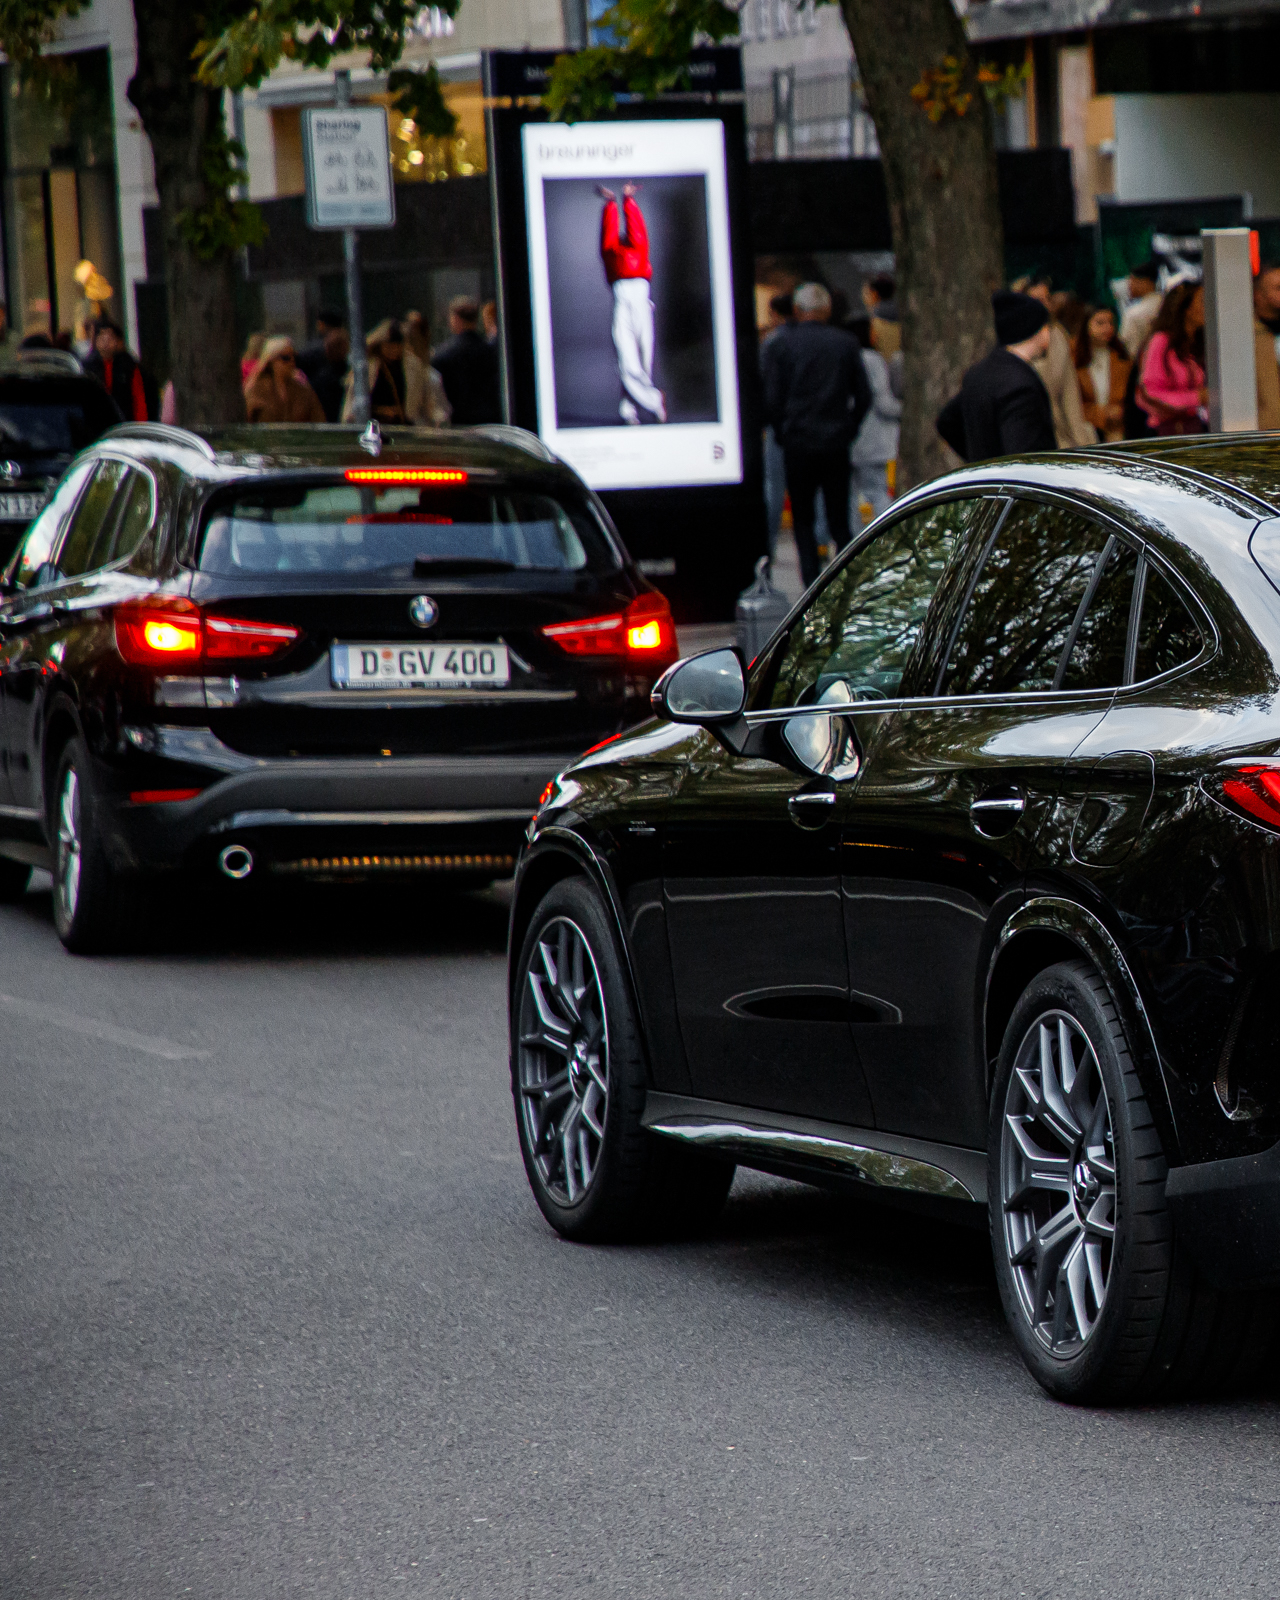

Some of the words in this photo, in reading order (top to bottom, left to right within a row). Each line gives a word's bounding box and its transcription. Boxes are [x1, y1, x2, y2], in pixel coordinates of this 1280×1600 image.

[361, 651, 379, 675] D
[399, 651, 434, 675] GV
[444, 651, 495, 675] 400
